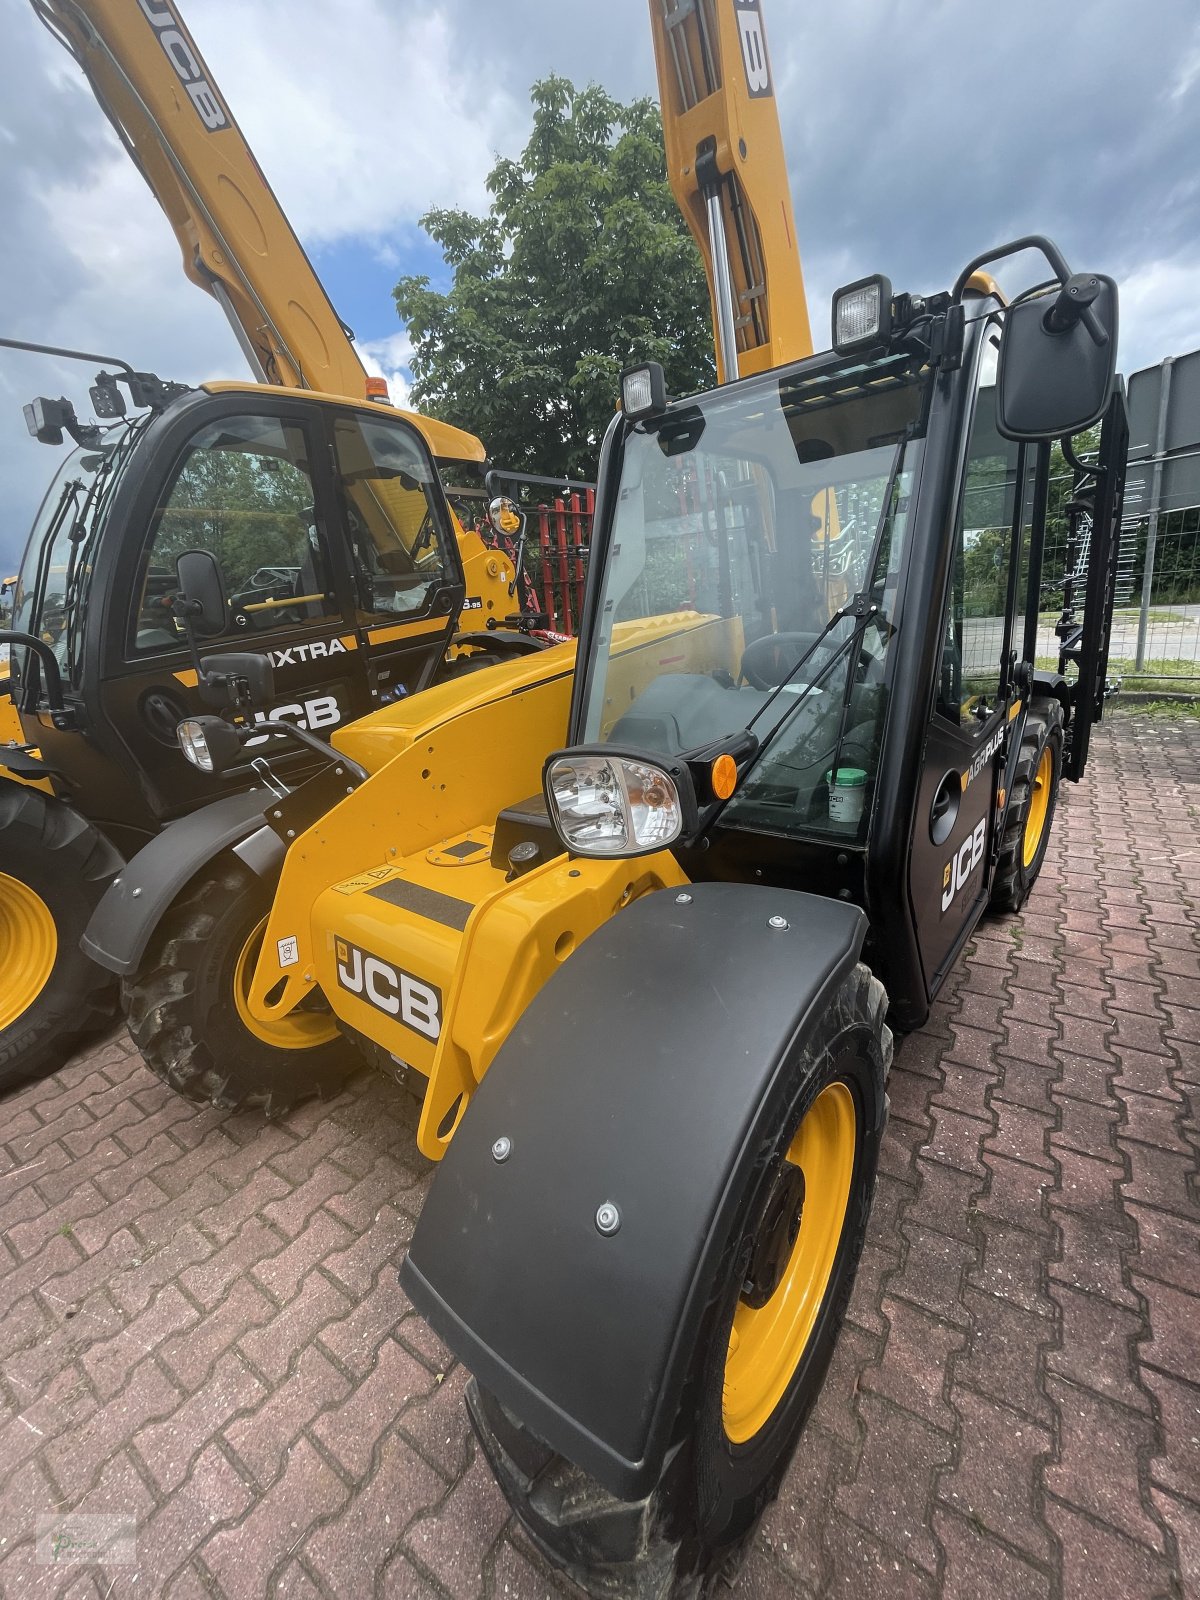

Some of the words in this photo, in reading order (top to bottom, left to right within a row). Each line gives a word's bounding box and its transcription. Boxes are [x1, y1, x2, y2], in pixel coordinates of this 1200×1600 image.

[139, 0, 226, 129] JCB
[941, 817, 986, 912] JCB
[338, 948, 440, 1039] JCB
